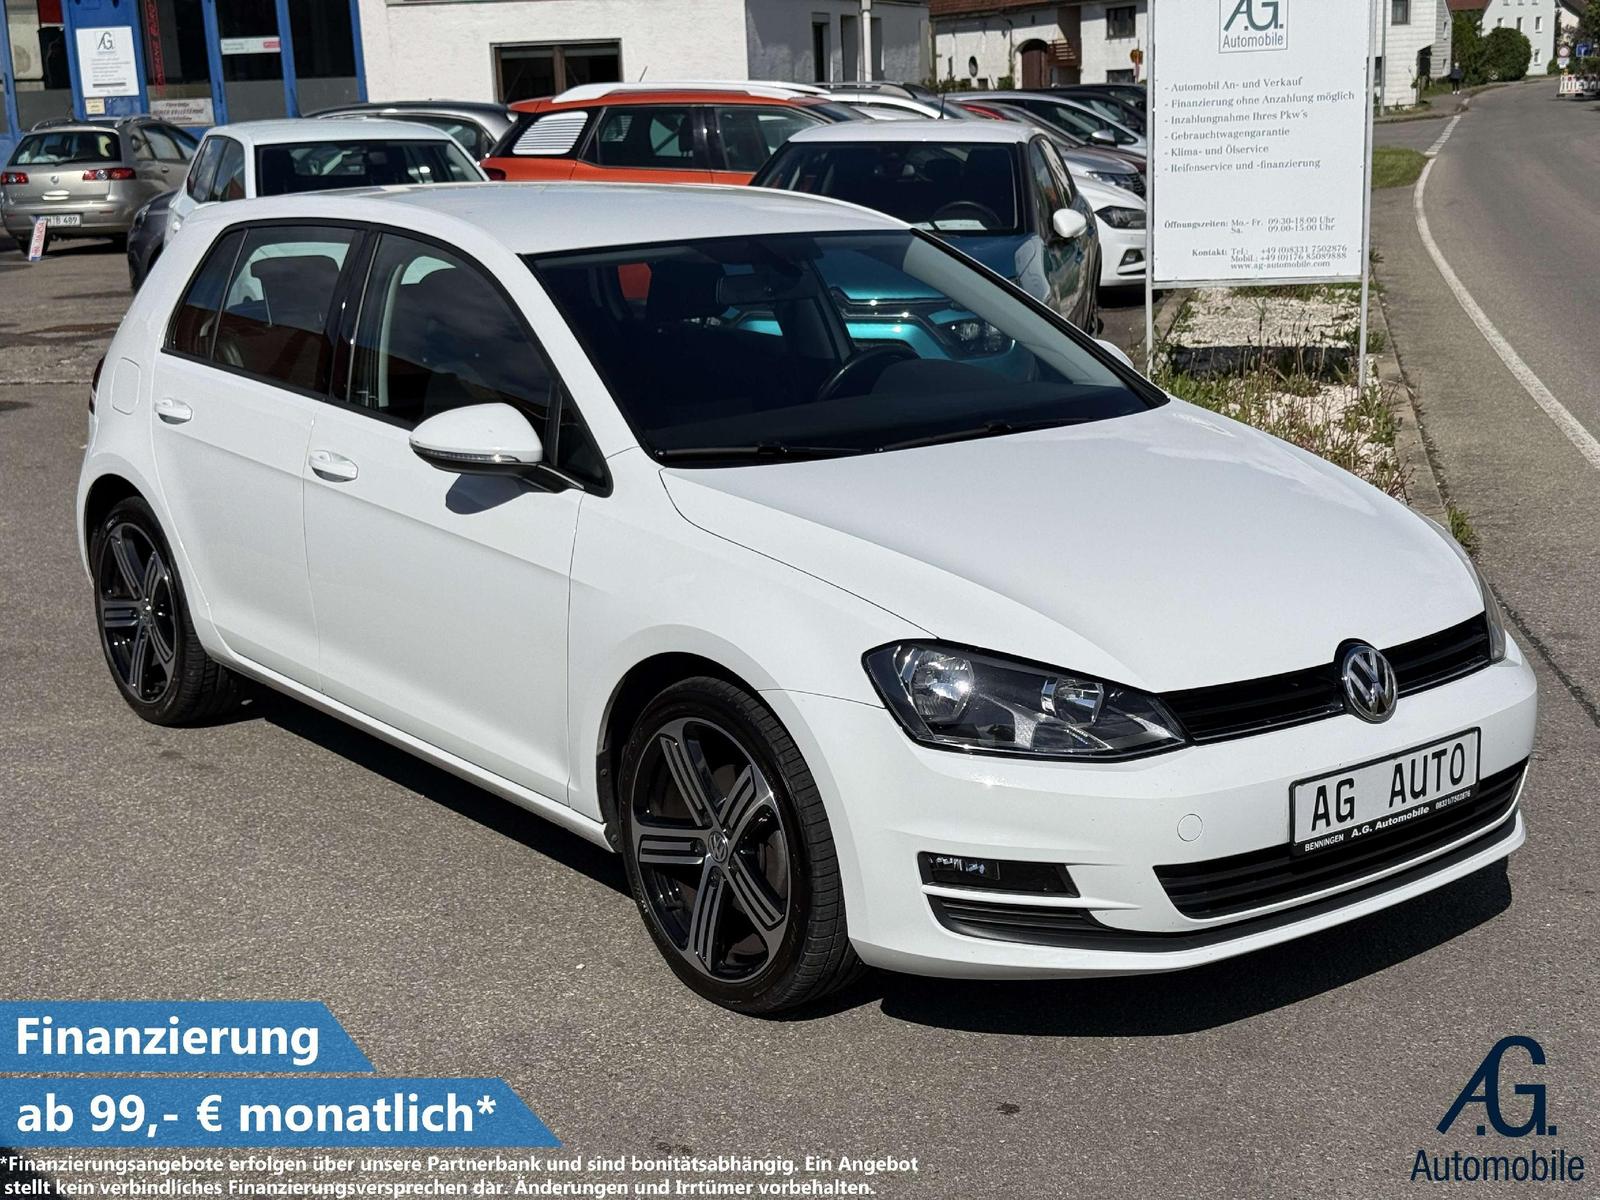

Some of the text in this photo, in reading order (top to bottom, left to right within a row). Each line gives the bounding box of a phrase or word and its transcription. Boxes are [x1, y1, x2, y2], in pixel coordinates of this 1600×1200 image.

[1223, 32, 1284, 48] Automobile
[1171, 76, 1303, 92] Automobil An- und Verkauf
[1171, 91, 1355, 108] Finanzierung ohne Anzahlung möglich
[1171, 113, 1250, 125] Inzahlungnahme
[1252, 111, 1277, 121] Ihres
[1170, 127, 1290, 141] Gebrauchtwagengarantie
[1171, 144, 1269, 157] Klima- und Ölservice
[1171, 159, 1321, 173] Reifenservice und -finanzierung
[1164, 219, 1228, 230] Öffnungszeiten:
[1319, 215, 1336, 224] Uhr
[1319, 223, 1336, 231] Uhr
[1192, 247, 1228, 257] Kontakt:
[1230, 260, 1331, 271] www.ag-automobile.com
[1311, 742, 1465, 832] AG AUTO
[1304, 834, 1344, 852] BENNINGEN
[1351, 825, 1372, 838] A.G.
[1375, 806, 1430, 830] Automobile
